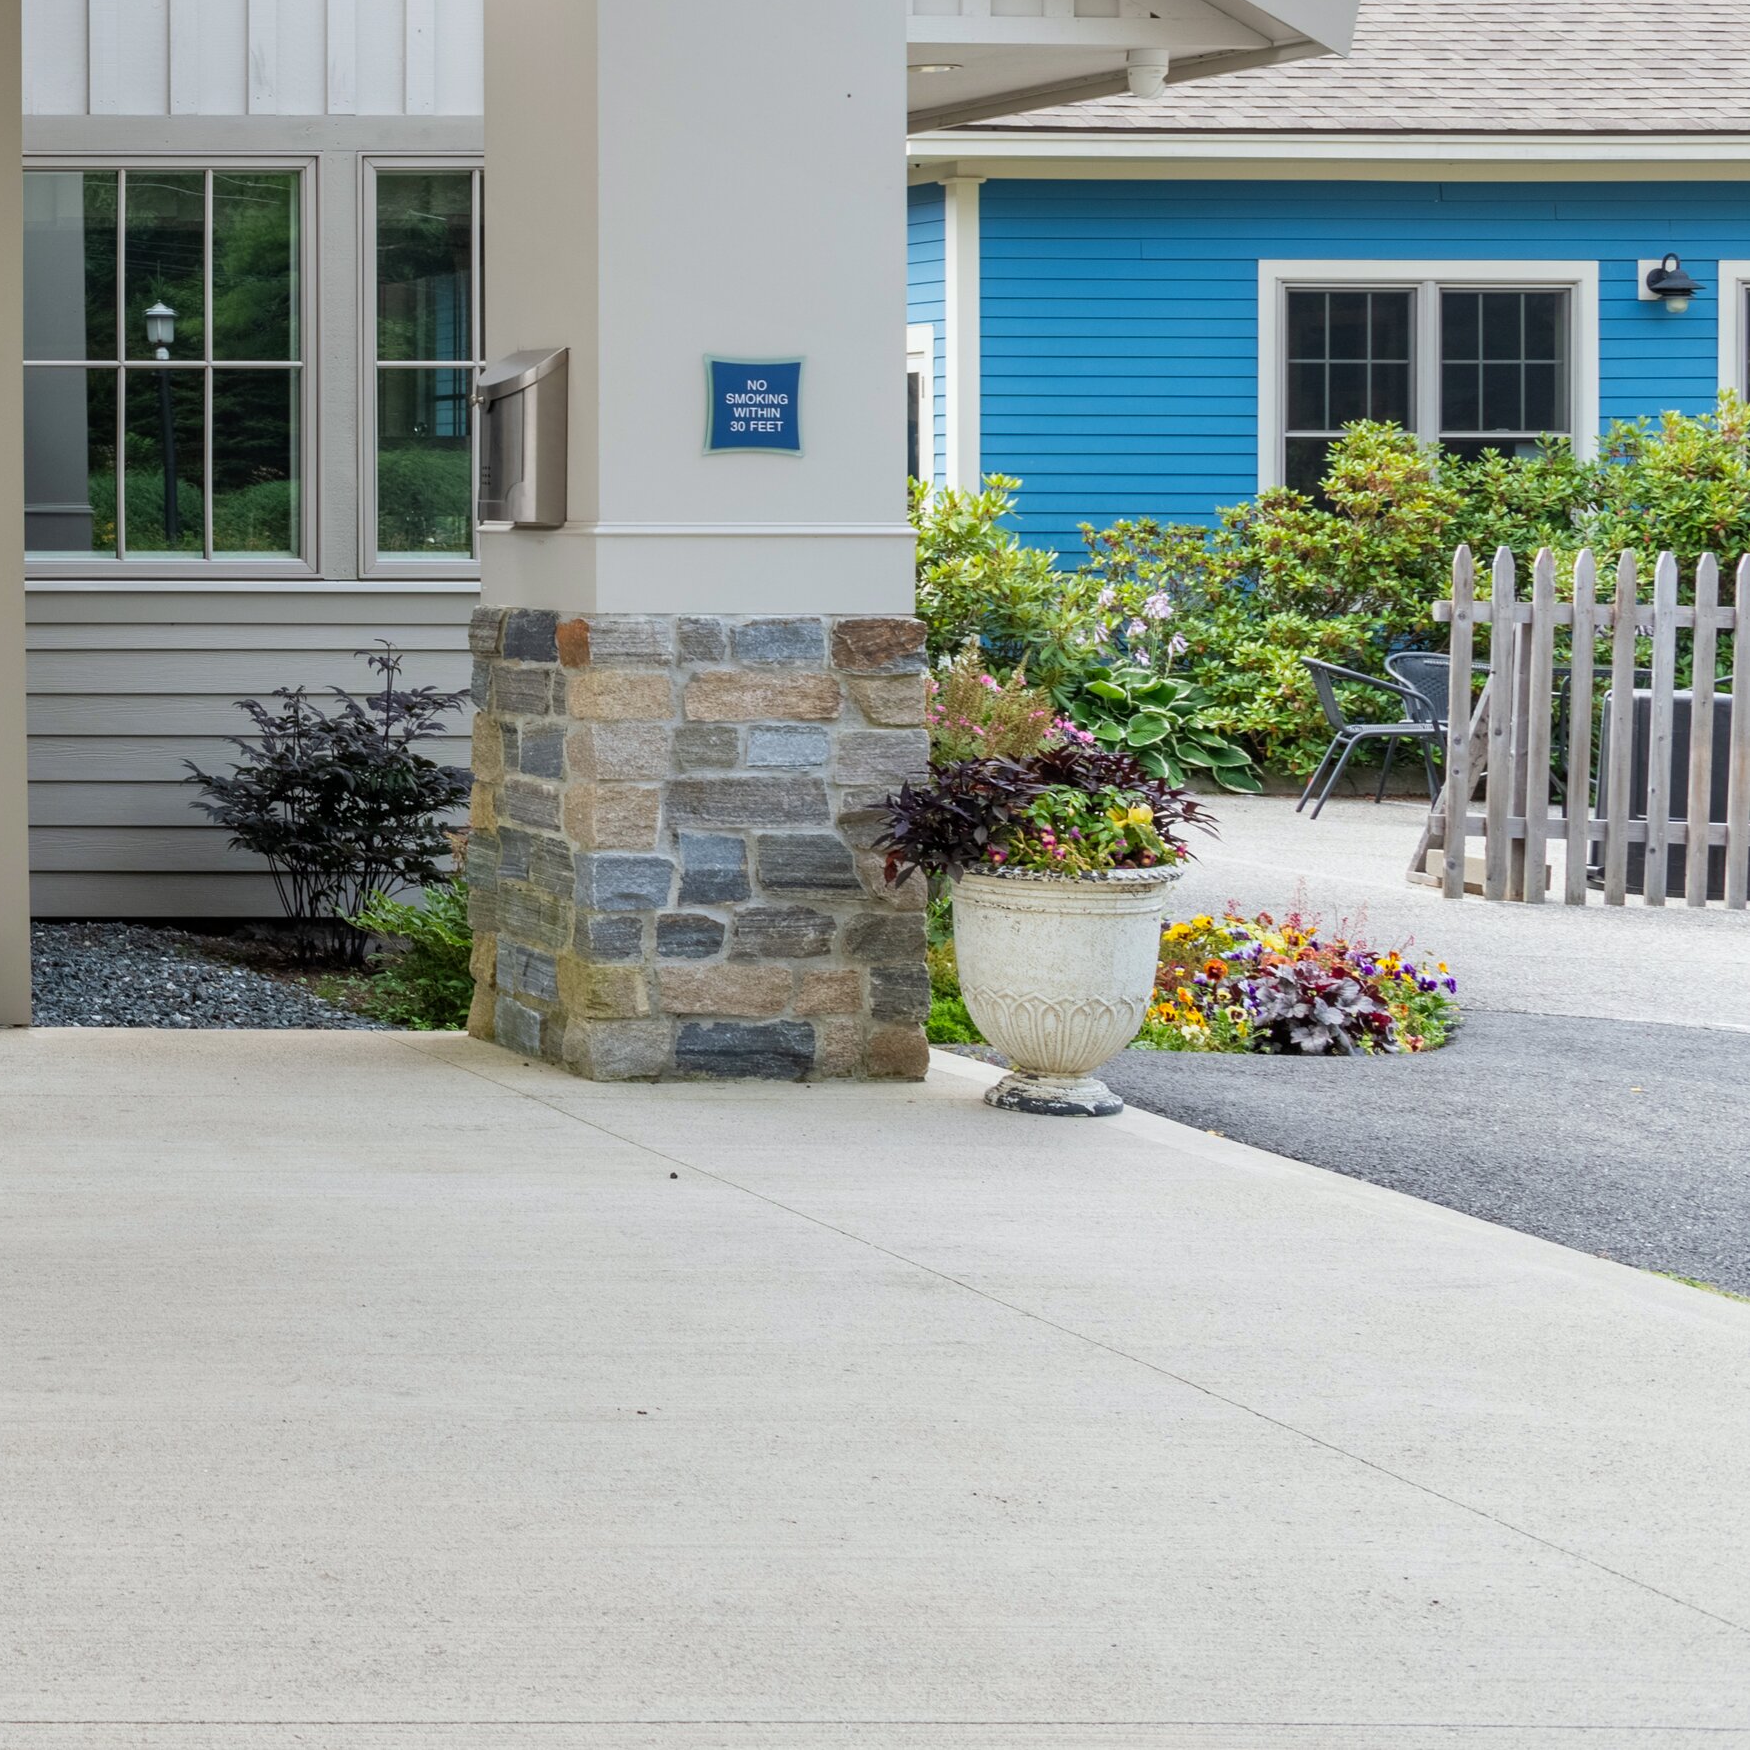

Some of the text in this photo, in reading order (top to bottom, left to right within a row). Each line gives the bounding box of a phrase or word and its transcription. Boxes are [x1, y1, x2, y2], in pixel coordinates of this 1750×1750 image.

[747, 380, 767, 390] NO
[725, 393, 788, 404] SMOKING
[733, 407, 780, 418] WITHIN
[730, 421, 784, 431] 30 FEET
